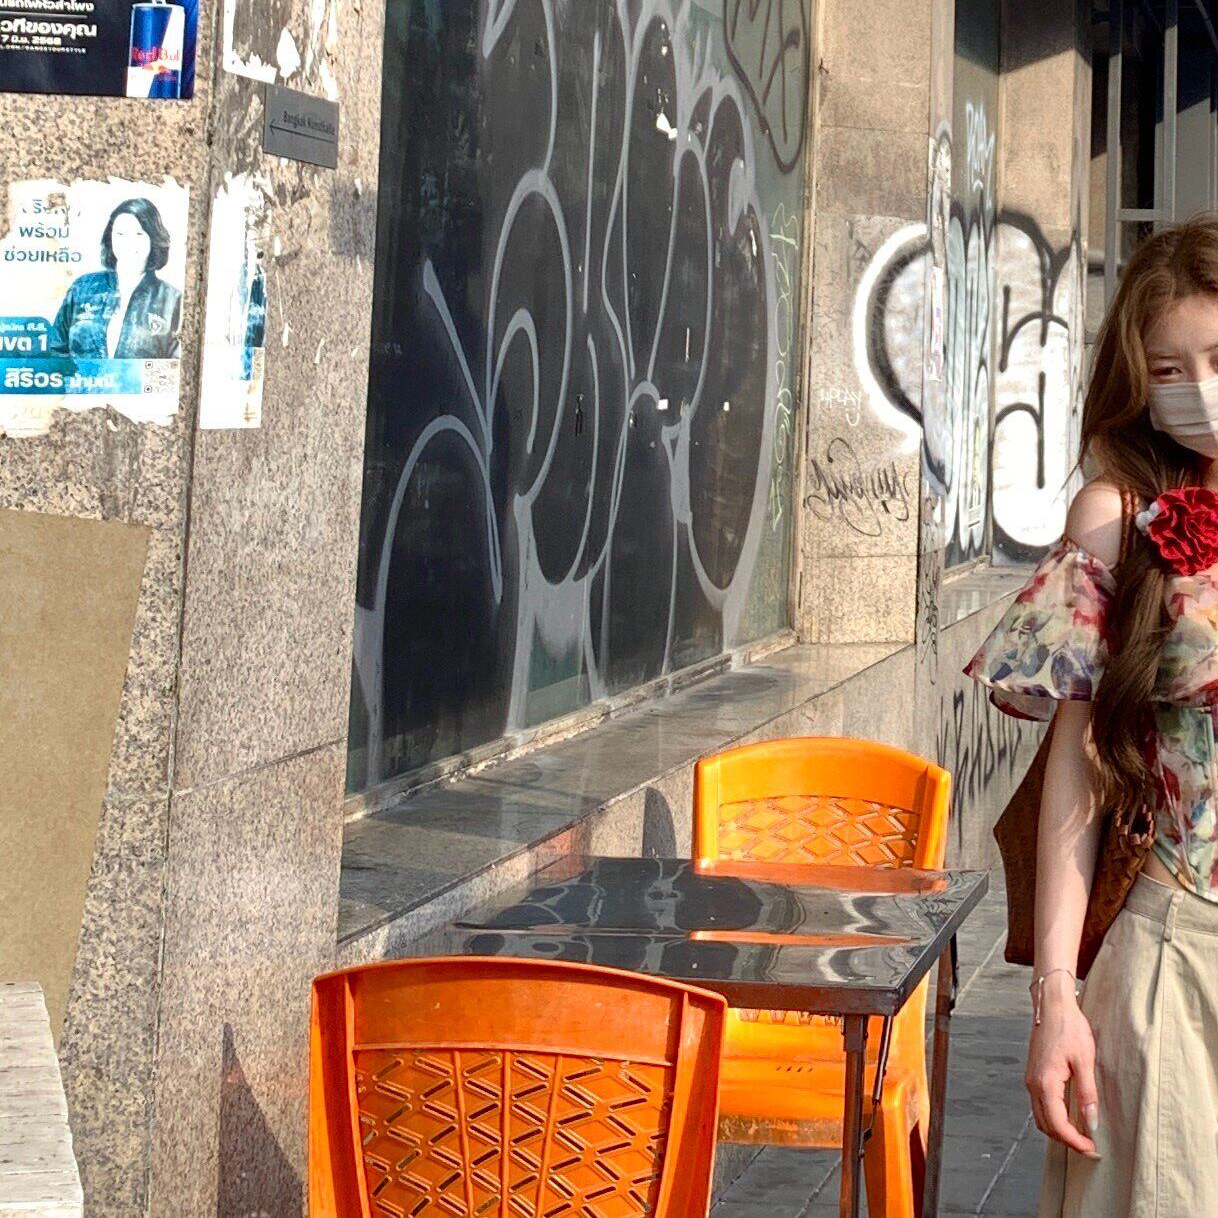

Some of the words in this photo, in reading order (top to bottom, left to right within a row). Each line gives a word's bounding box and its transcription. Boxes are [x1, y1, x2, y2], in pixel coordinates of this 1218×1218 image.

[19, 222, 70, 239] พร้อม
[4, 245, 82, 263] ช่วยเหลือ
[38, 334, 48, 351] 1
